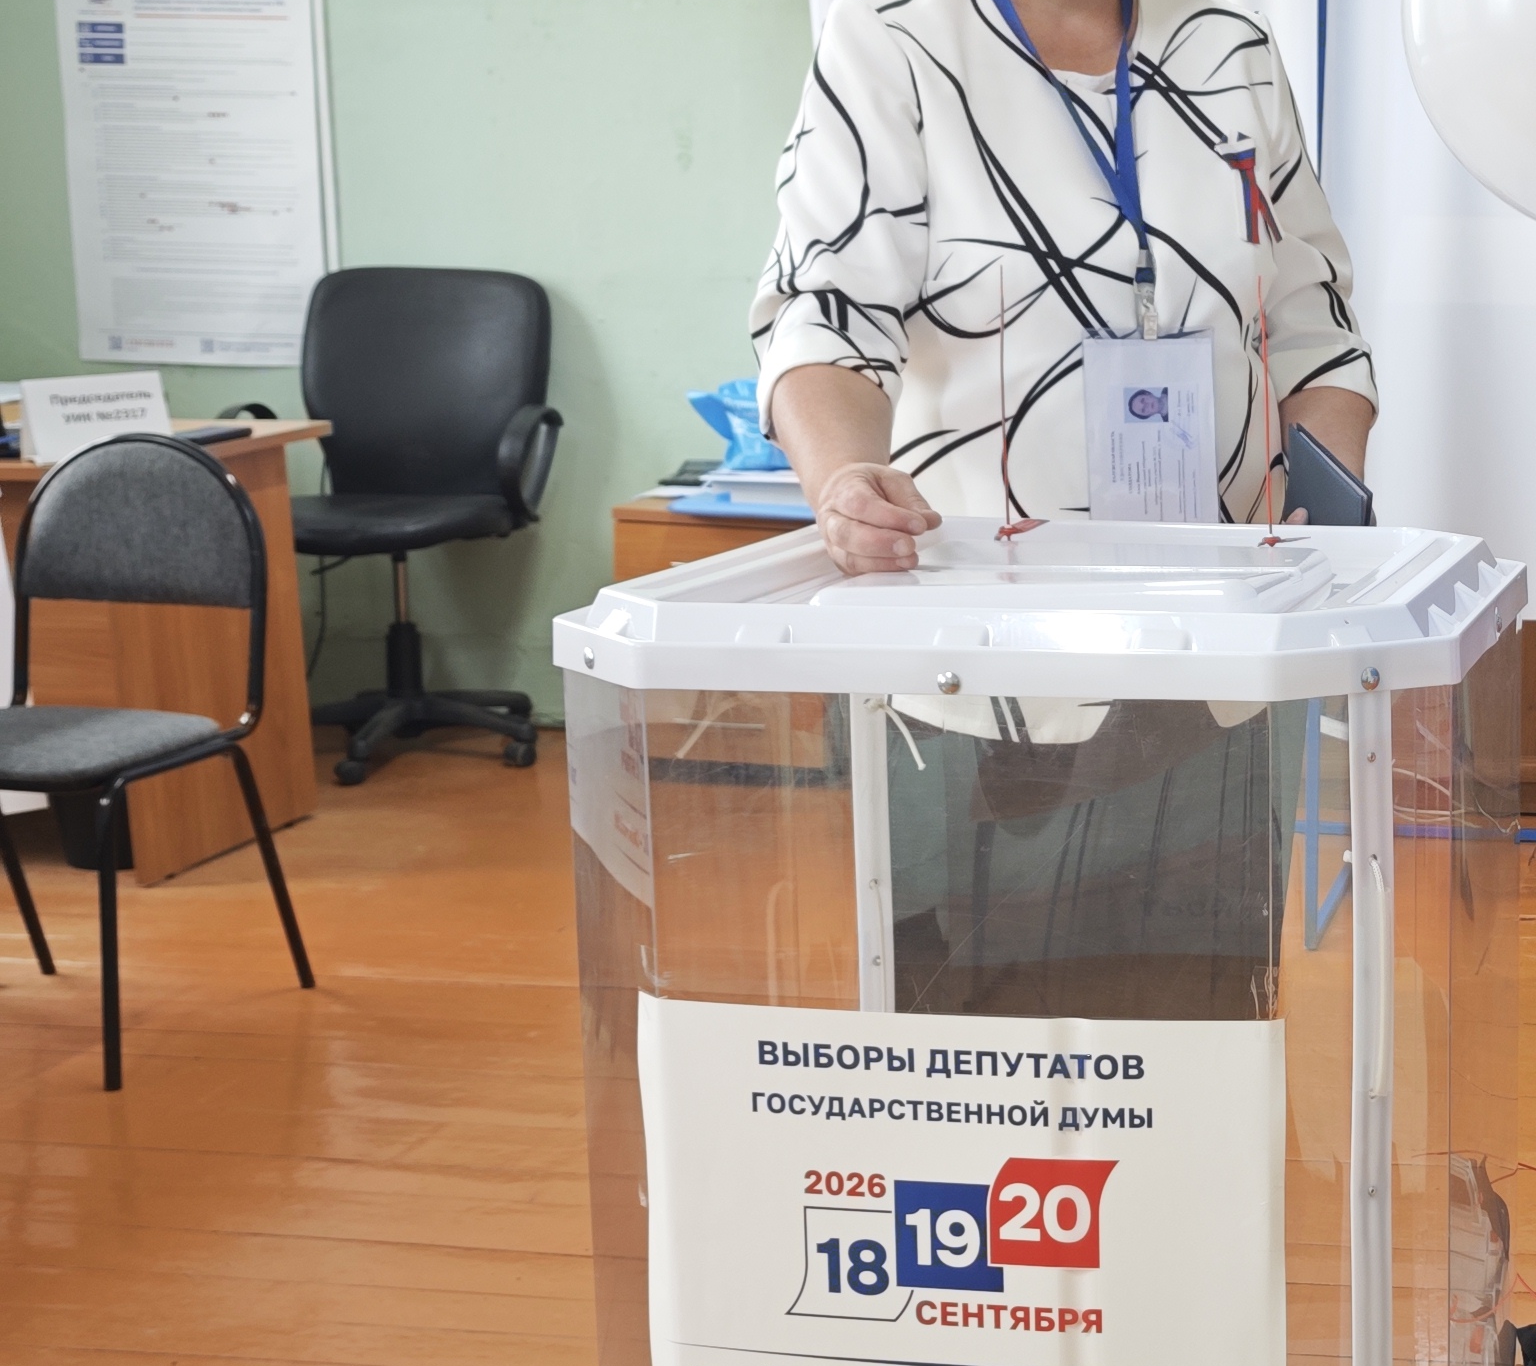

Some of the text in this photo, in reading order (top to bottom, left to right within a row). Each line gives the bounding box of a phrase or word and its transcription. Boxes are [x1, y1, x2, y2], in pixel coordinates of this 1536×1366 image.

[758, 1040, 1145, 1081] ВЫБОРЫ ДЕПУТАТОВ
[751, 1092, 1153, 1132] ГОСУДАРСТВЕННОЙ ДУМЫ
[804, 1170, 886, 1198] 2026
[816, 1184, 1091, 1295] 18 19 20
[915, 1300, 1103, 1334] СЕНТЯБРЯ
